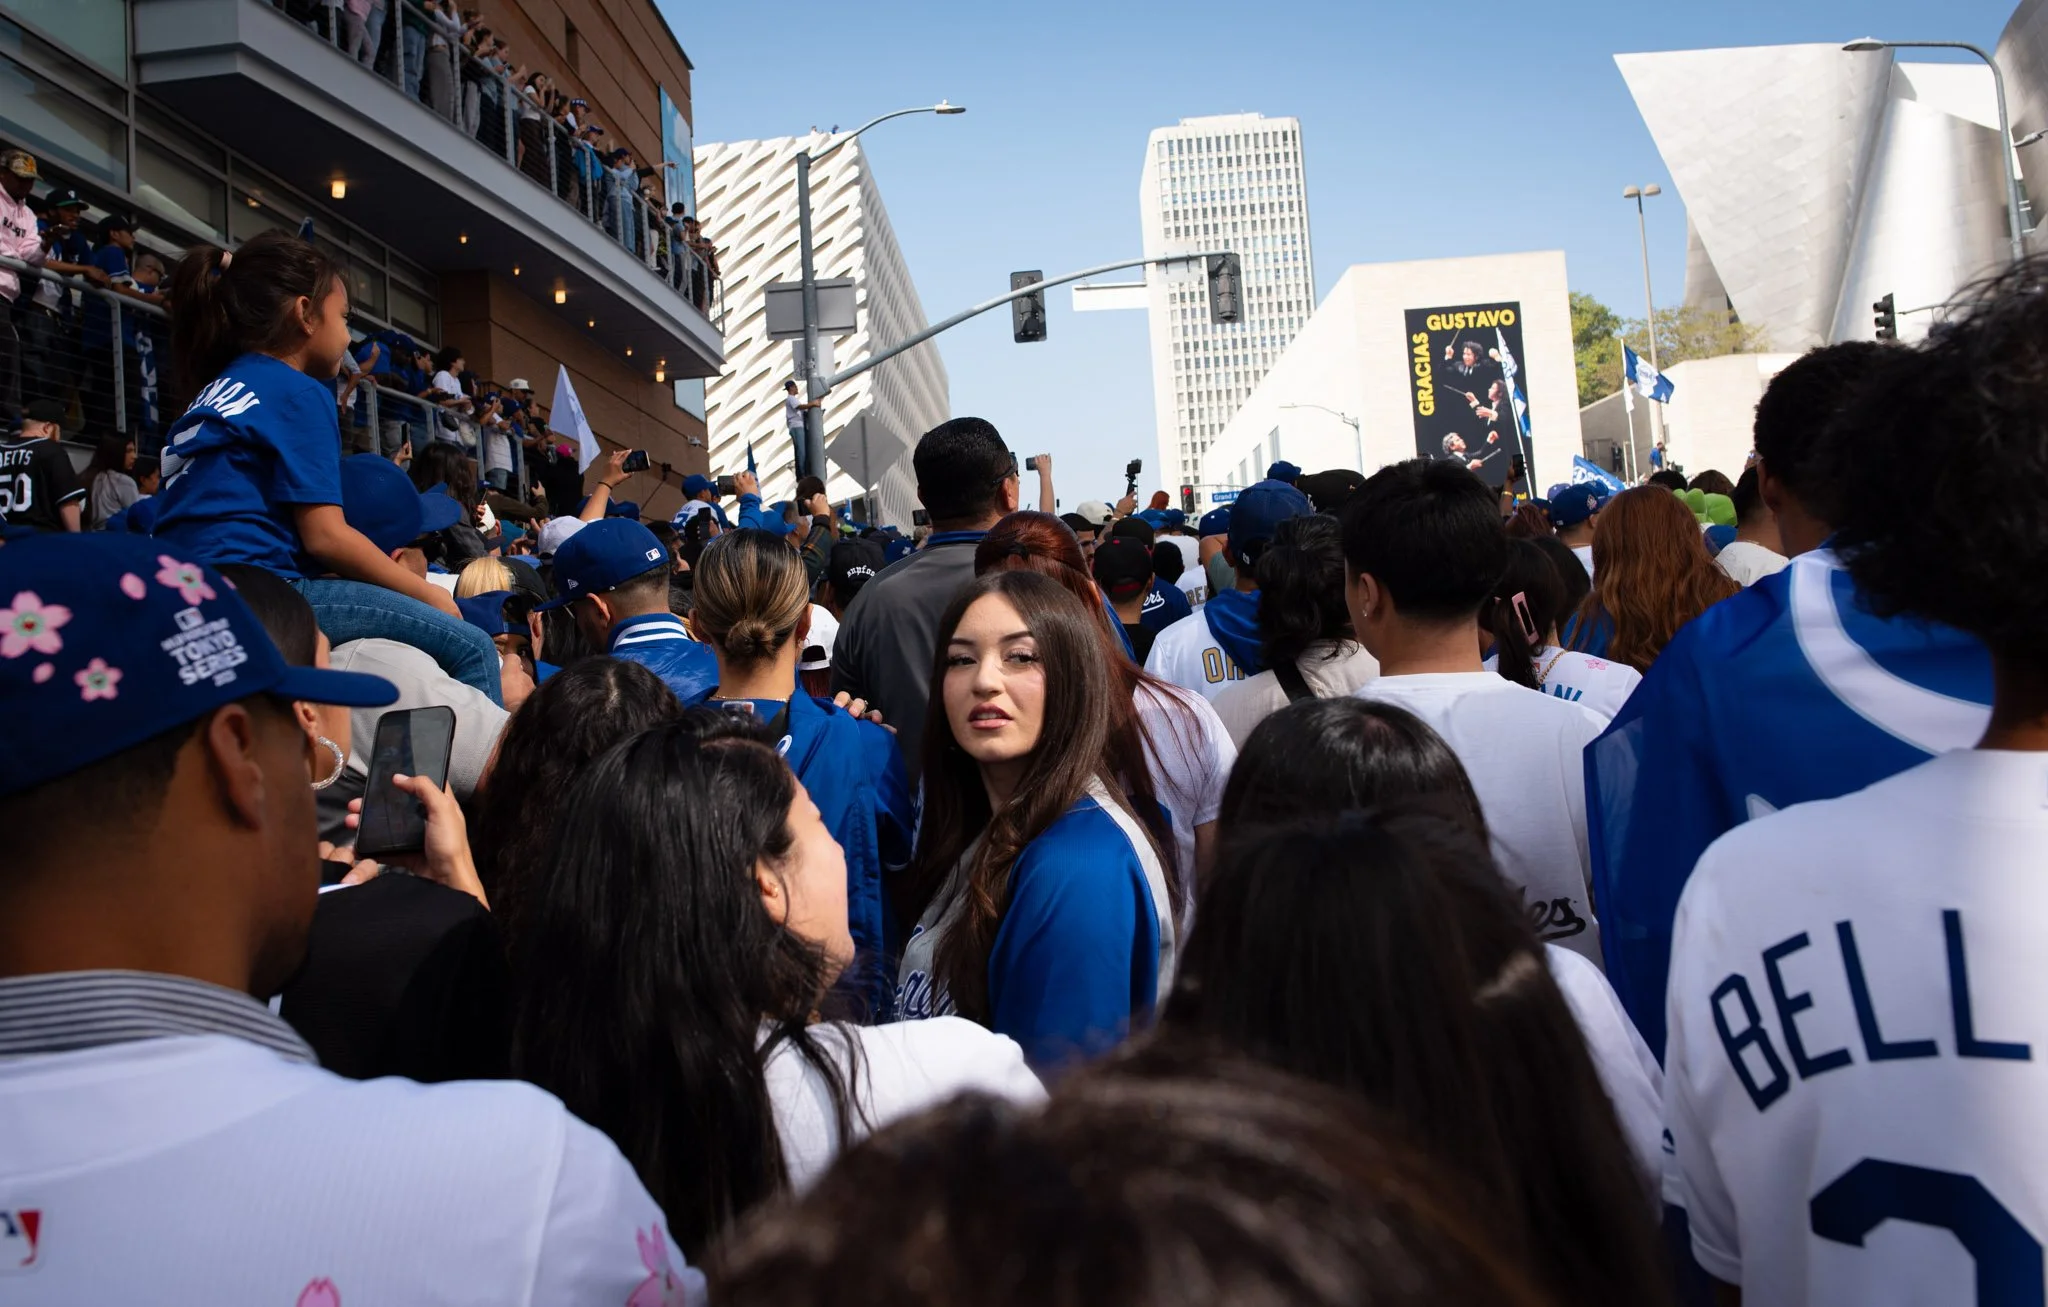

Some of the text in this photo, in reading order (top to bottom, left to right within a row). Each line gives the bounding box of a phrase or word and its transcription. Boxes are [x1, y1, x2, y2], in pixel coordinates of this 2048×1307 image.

[1426, 309, 1515, 331] GUSTAVO
[1412, 332, 1435, 416] GRACIAS
[0, 472, 32, 513] 50
[1213, 493, 1232, 501] Grand
[169, 629, 237, 667] TOKYO
[178, 644, 248, 686] SERIES
[1710, 908, 2033, 1113] BELL
